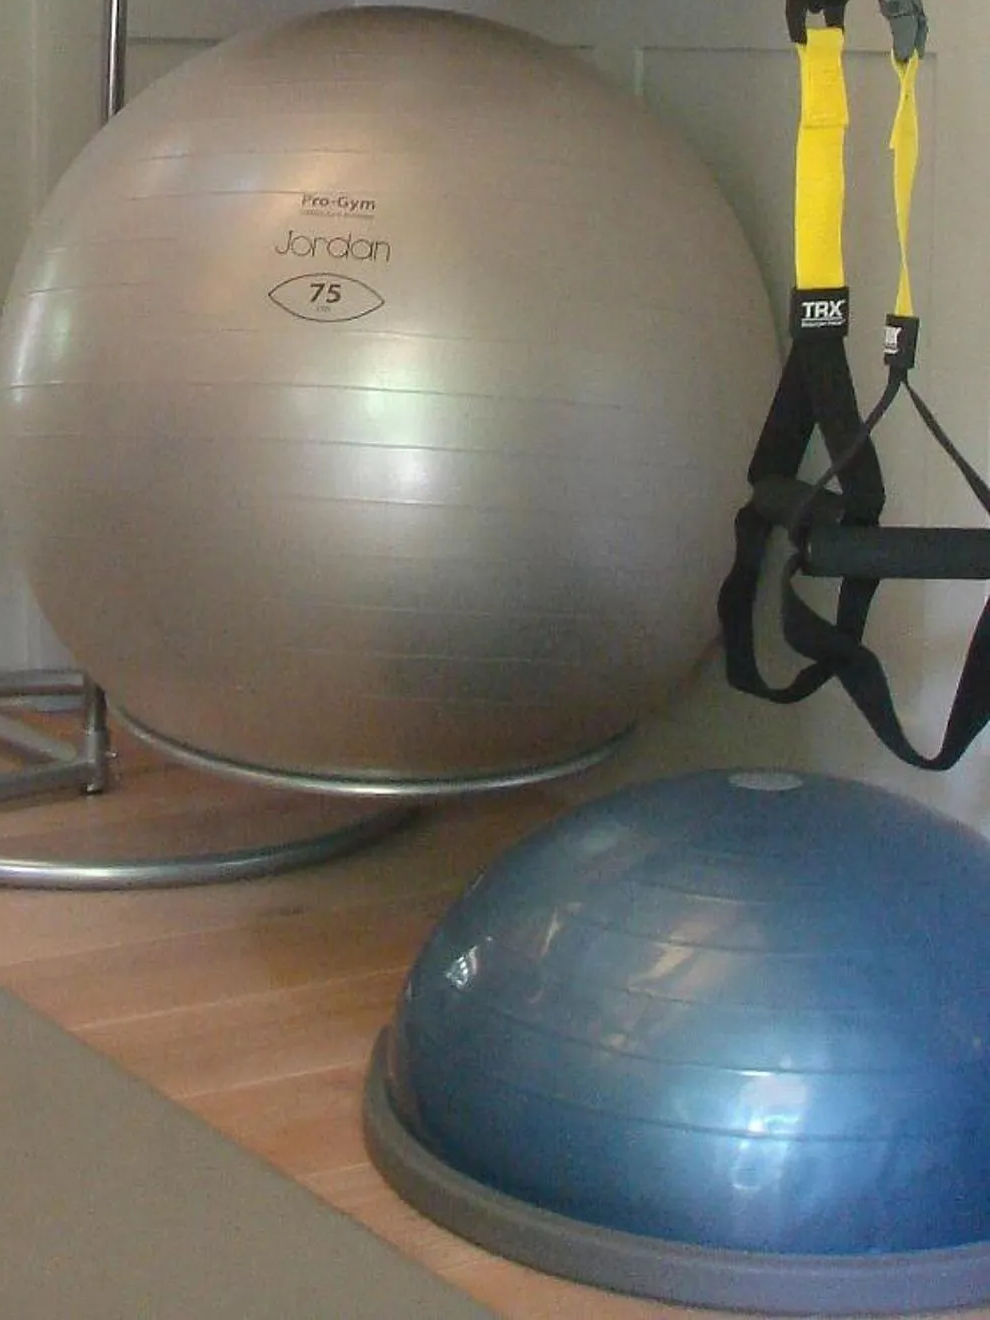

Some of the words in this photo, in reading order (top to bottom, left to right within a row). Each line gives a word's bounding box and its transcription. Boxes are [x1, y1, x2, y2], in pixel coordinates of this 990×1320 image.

[302, 194, 376, 212] Pro-Gym
[275, 230, 391, 262] Jordan
[310, 282, 342, 304] 75
[802, 299, 846, 318] TRX
